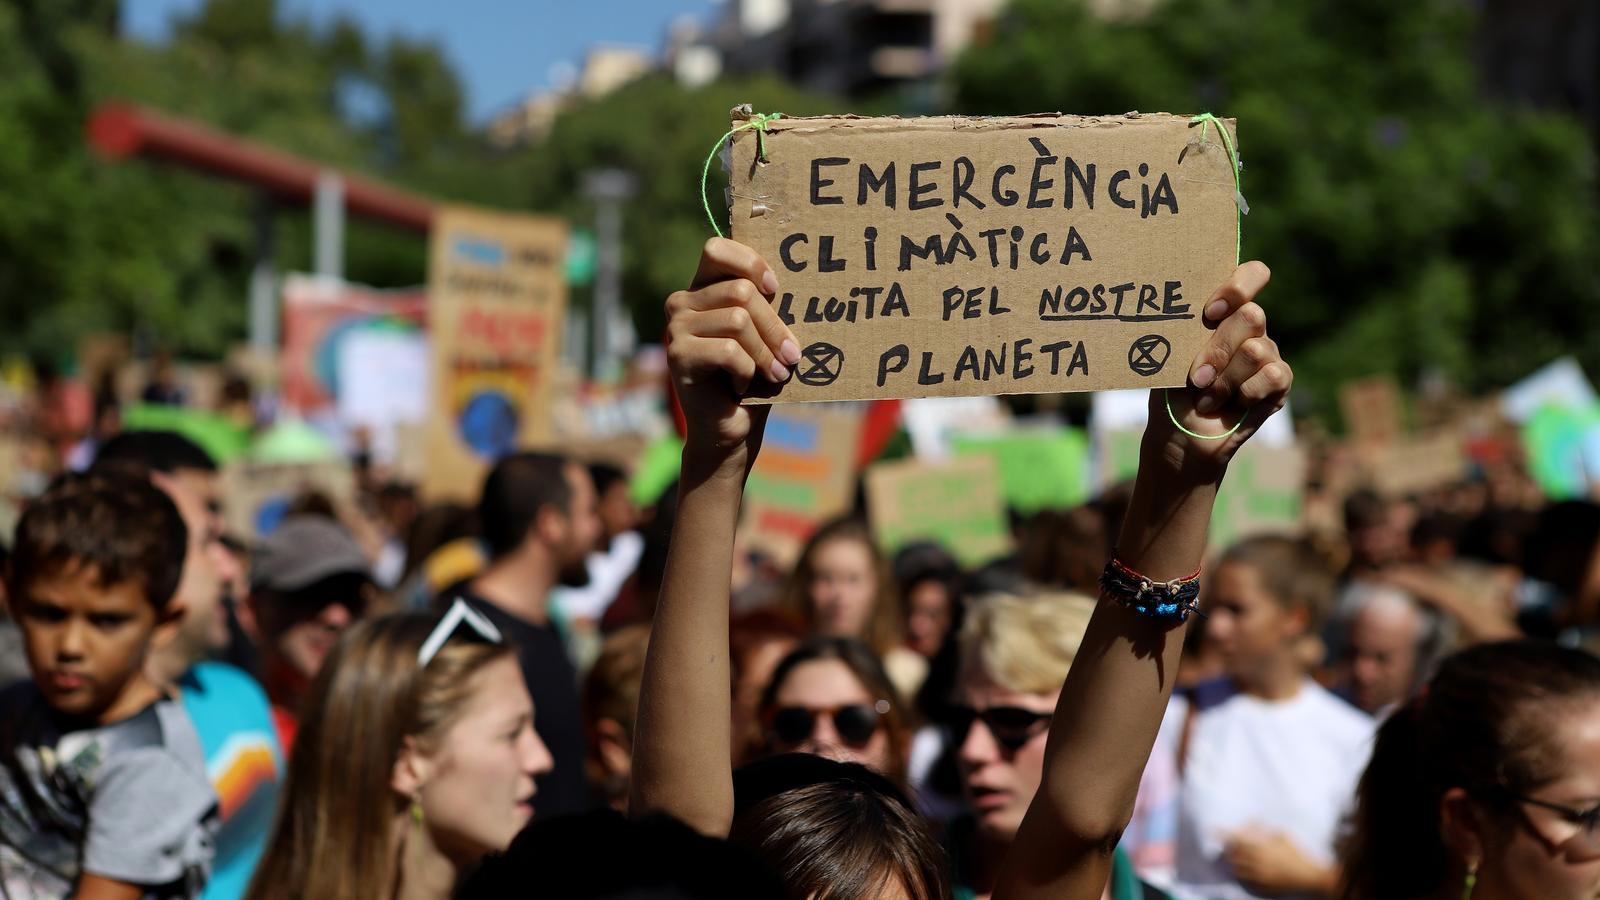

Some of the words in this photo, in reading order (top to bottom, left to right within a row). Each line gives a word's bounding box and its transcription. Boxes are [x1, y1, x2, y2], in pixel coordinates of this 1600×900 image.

[942, 285, 1012, 322] PEL
[1039, 280, 1194, 321] NOSTRE
[876, 338, 1090, 388] PLANETA
